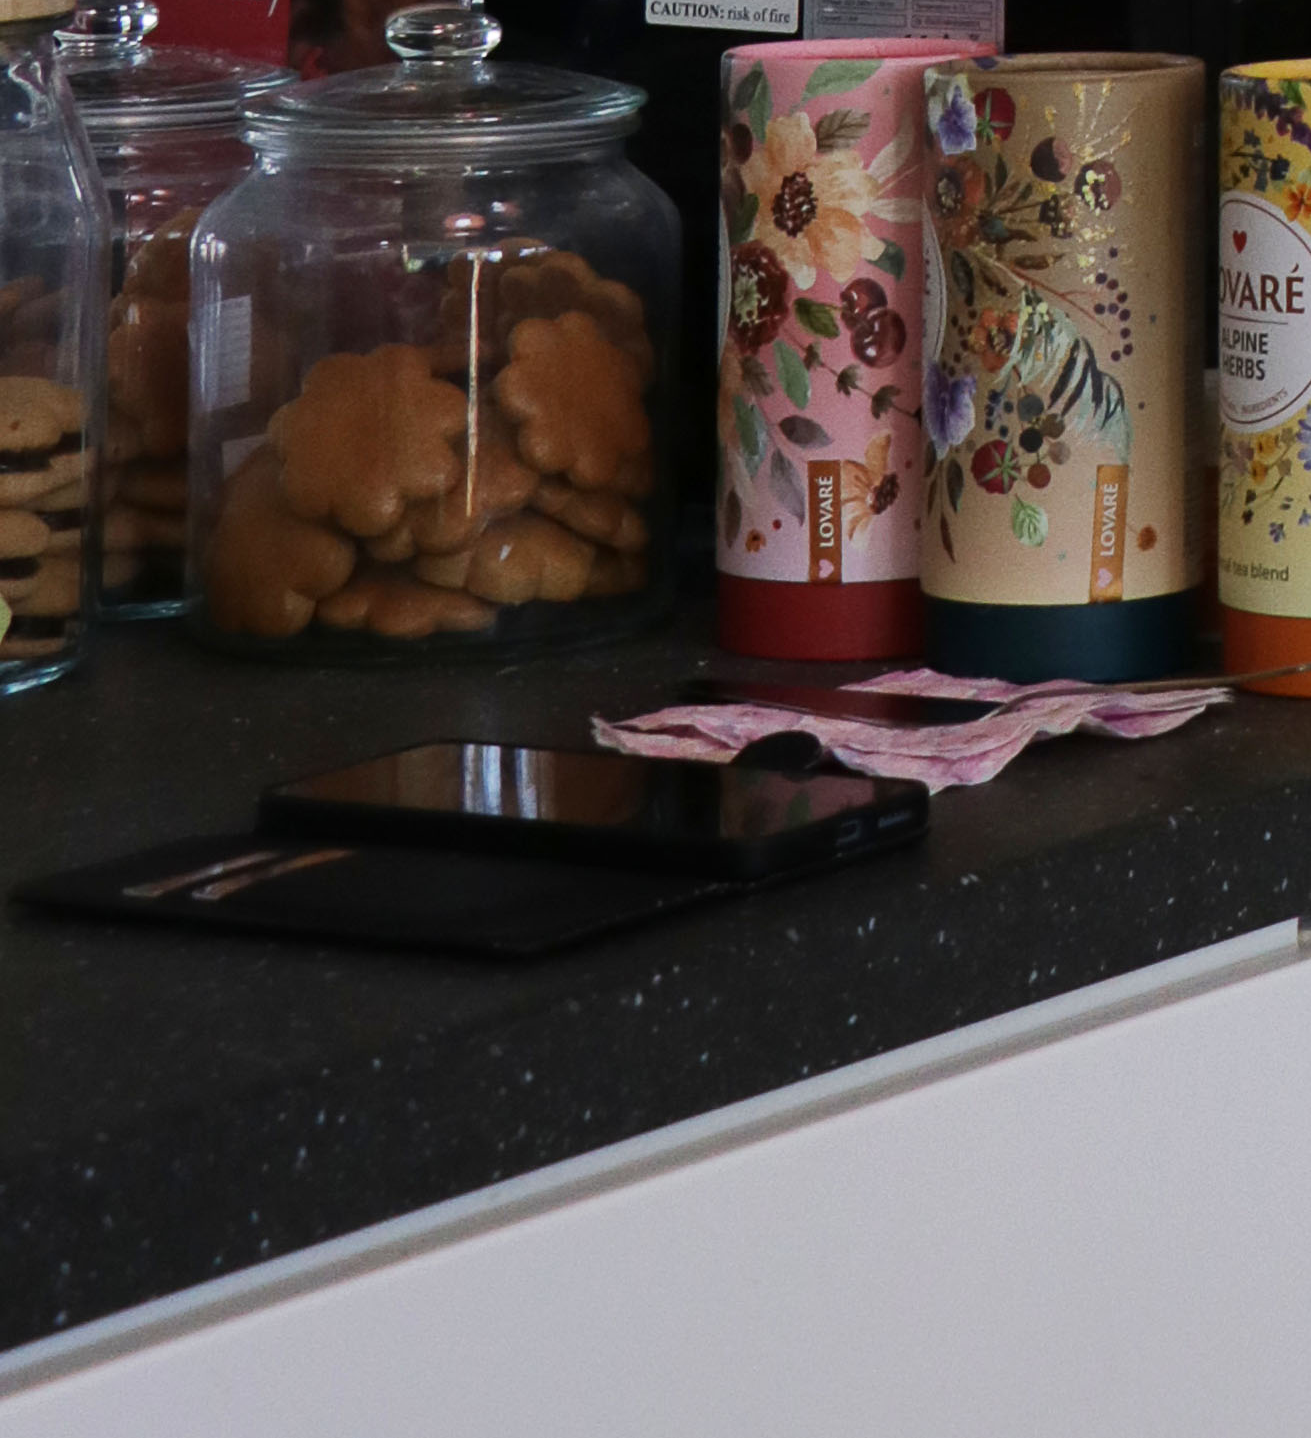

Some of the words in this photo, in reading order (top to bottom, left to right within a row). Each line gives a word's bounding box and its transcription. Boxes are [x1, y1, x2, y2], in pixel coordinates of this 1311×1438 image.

[650, 0, 725, 19] CAUTION:
[727, 6, 750, 22] risk
[753, 8, 770, 23] of
[769, 9, 791, 24] fire
[1219, 262, 1305, 314] OVARÉ
[1222, 328, 1268, 355] ALPINE
[818, 475, 833, 549] LOVARÉ
[1251, 561, 1289, 582] blend
